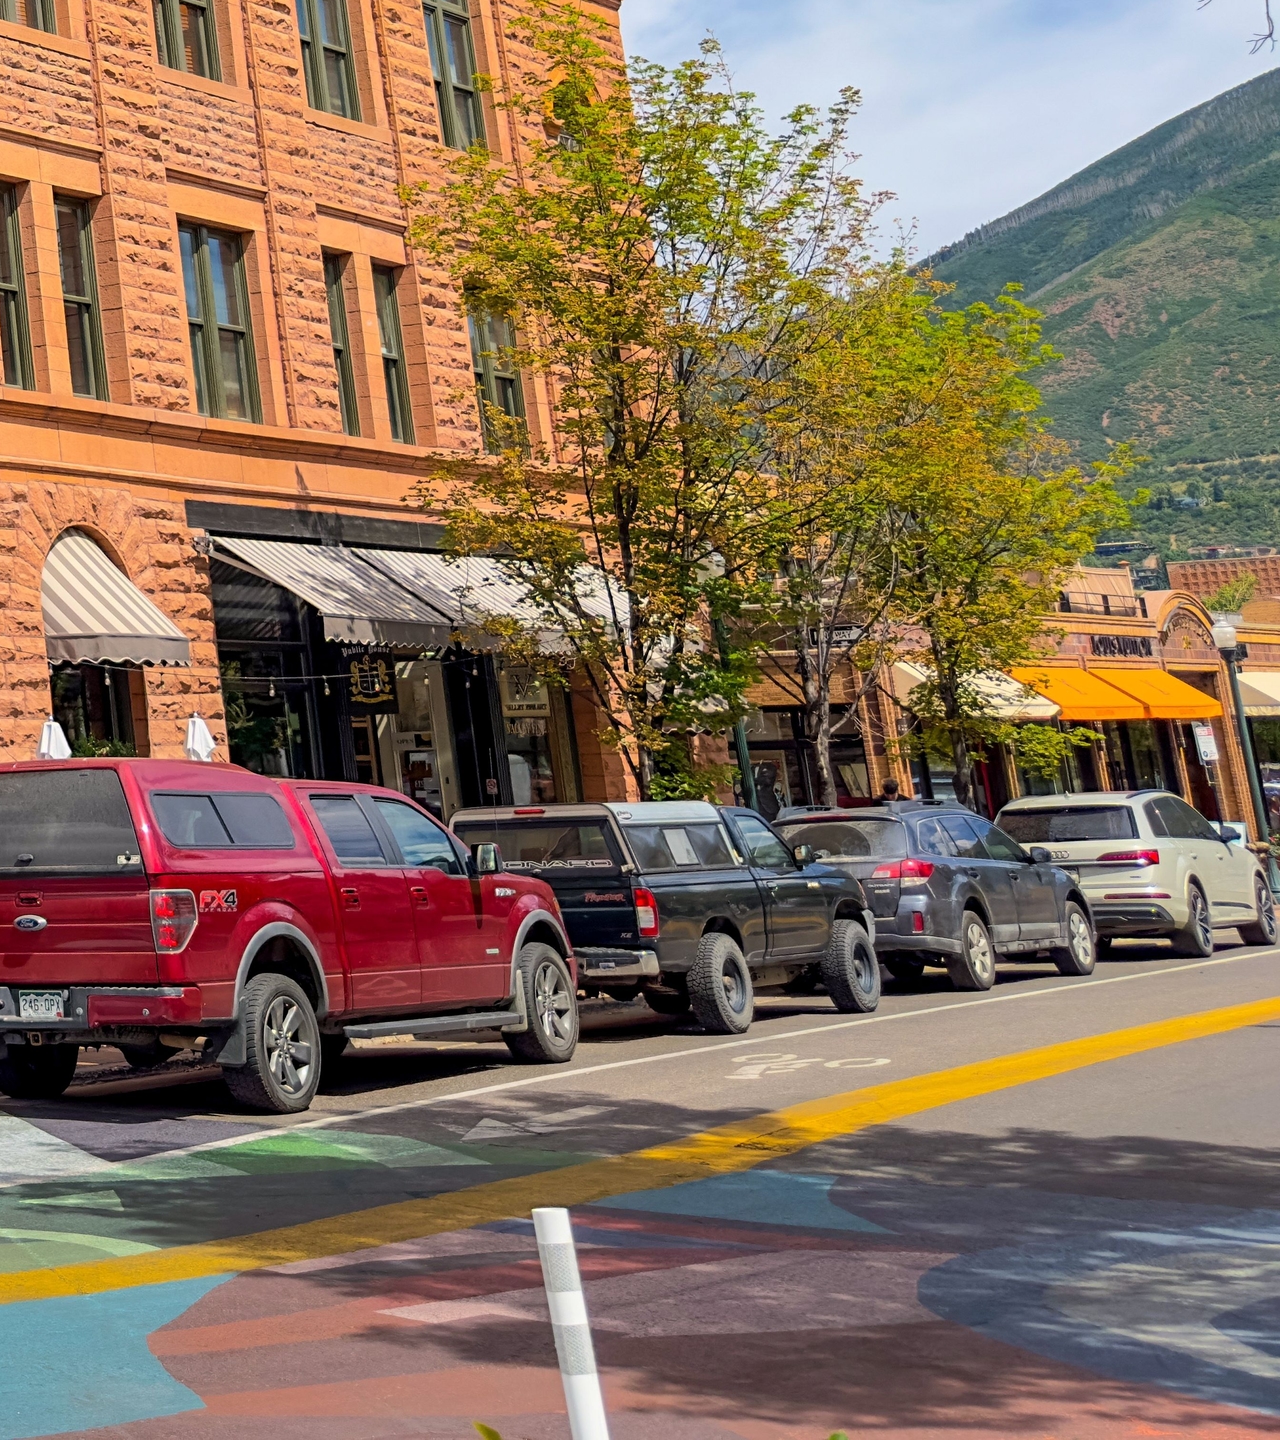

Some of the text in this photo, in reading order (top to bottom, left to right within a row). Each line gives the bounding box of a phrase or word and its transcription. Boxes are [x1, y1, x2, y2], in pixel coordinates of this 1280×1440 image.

[341, 645, 390, 657] Public House
[199, 889, 238, 907] FX4
